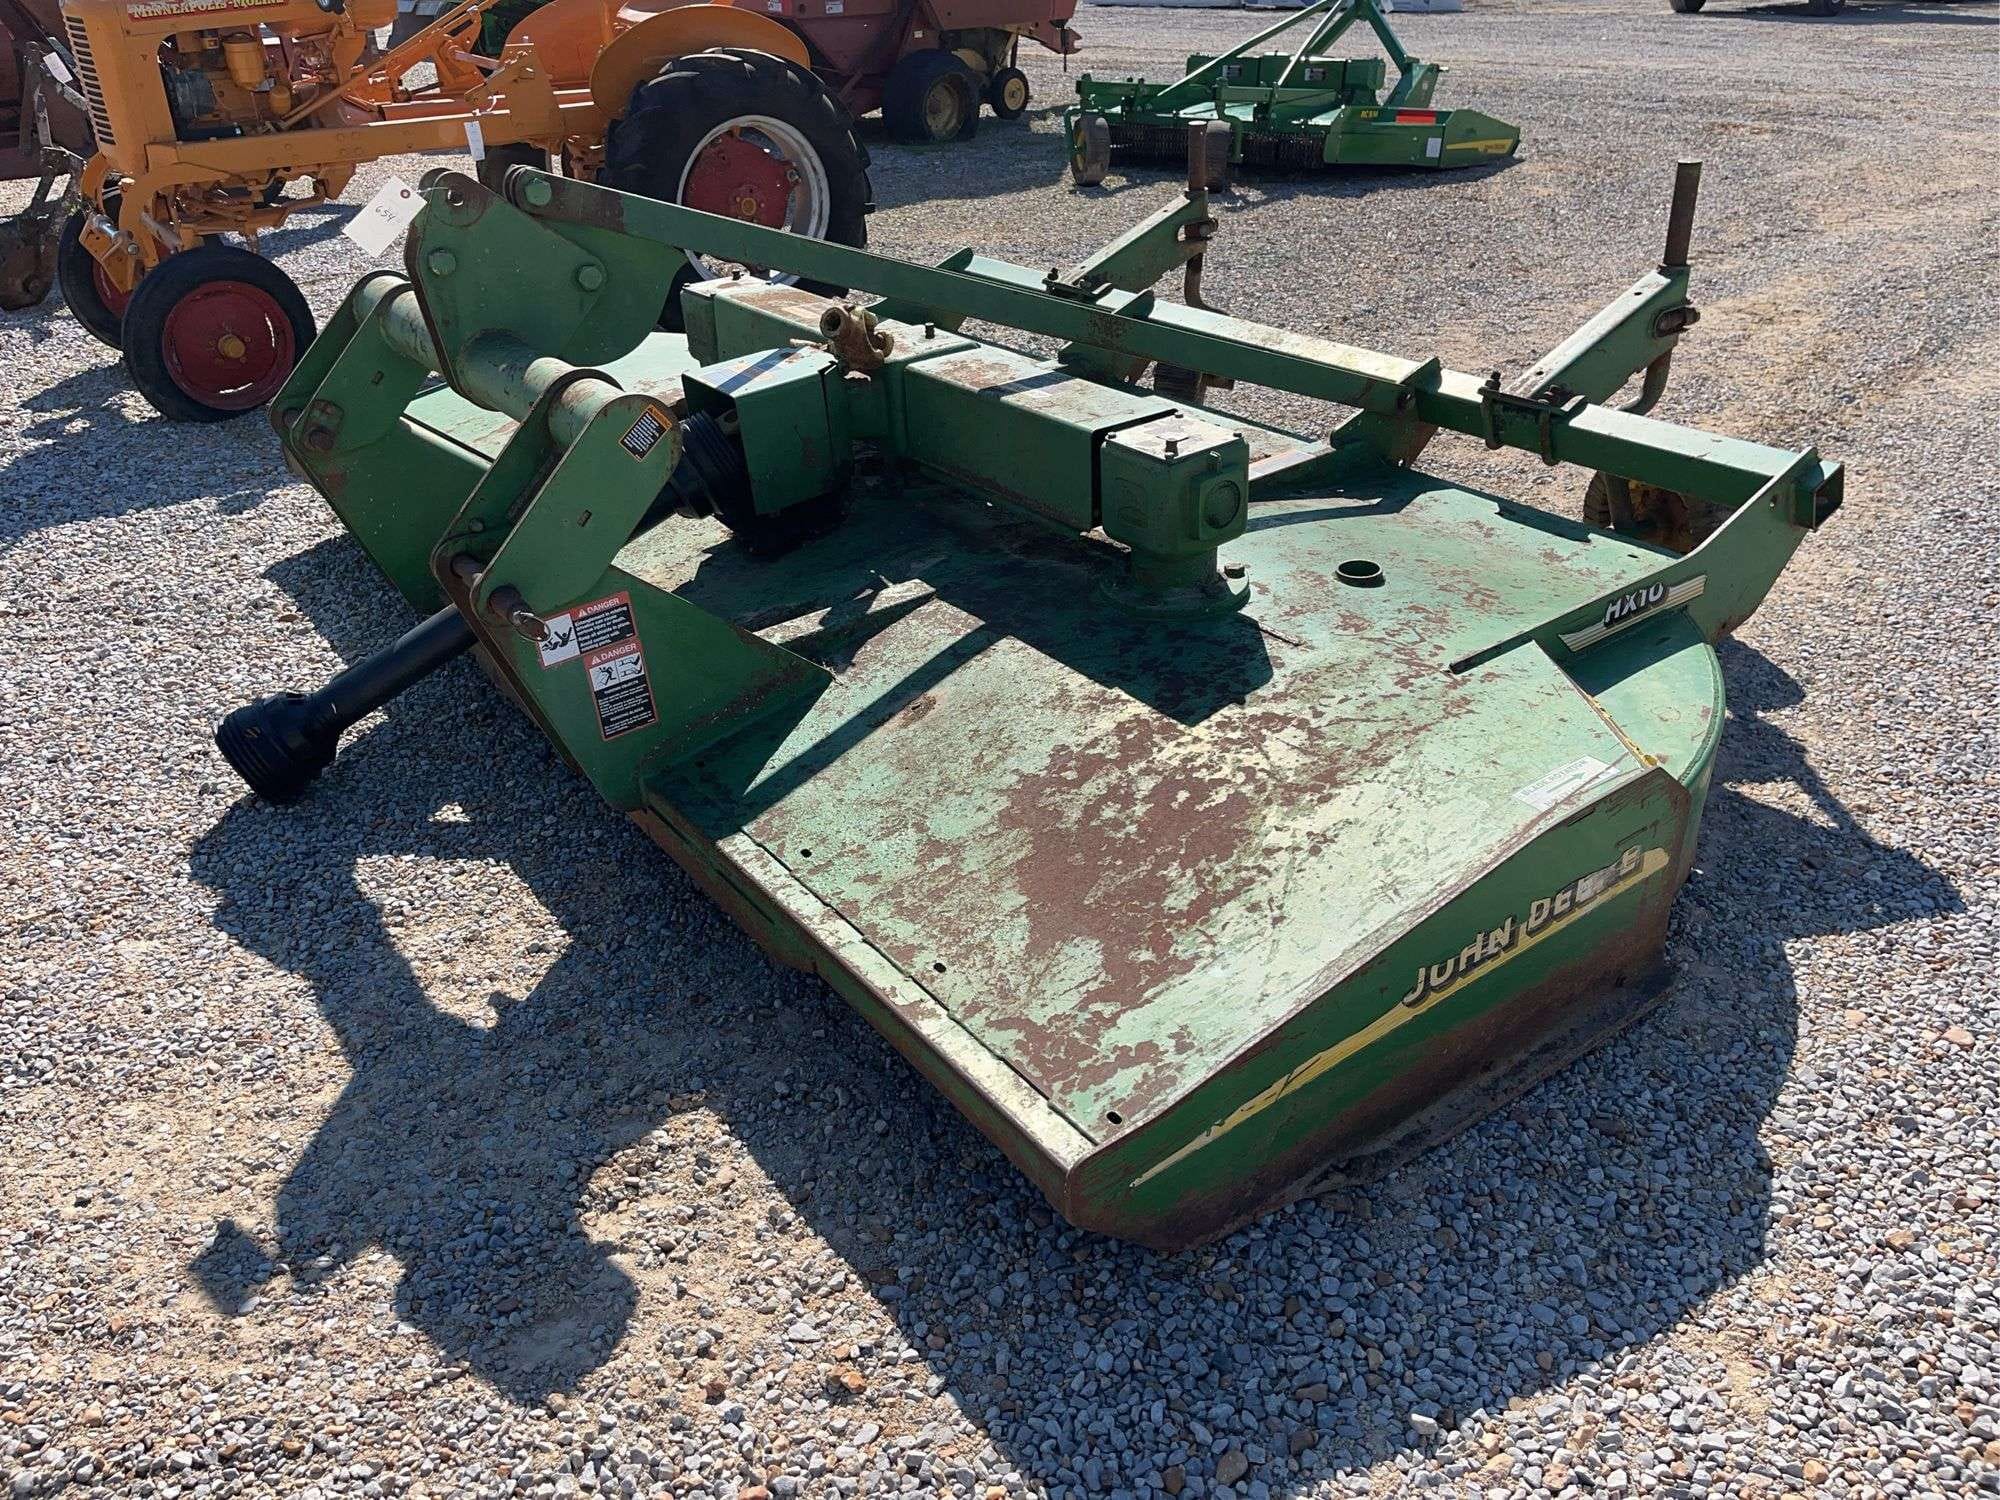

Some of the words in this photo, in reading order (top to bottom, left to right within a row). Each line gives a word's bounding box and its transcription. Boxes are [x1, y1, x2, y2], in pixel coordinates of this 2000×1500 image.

[587, 598, 620, 612] DANGER
[1604, 582, 1664, 623] HX10
[600, 642, 637, 660] DANGER
[1527, 844, 1641, 932] DEE
